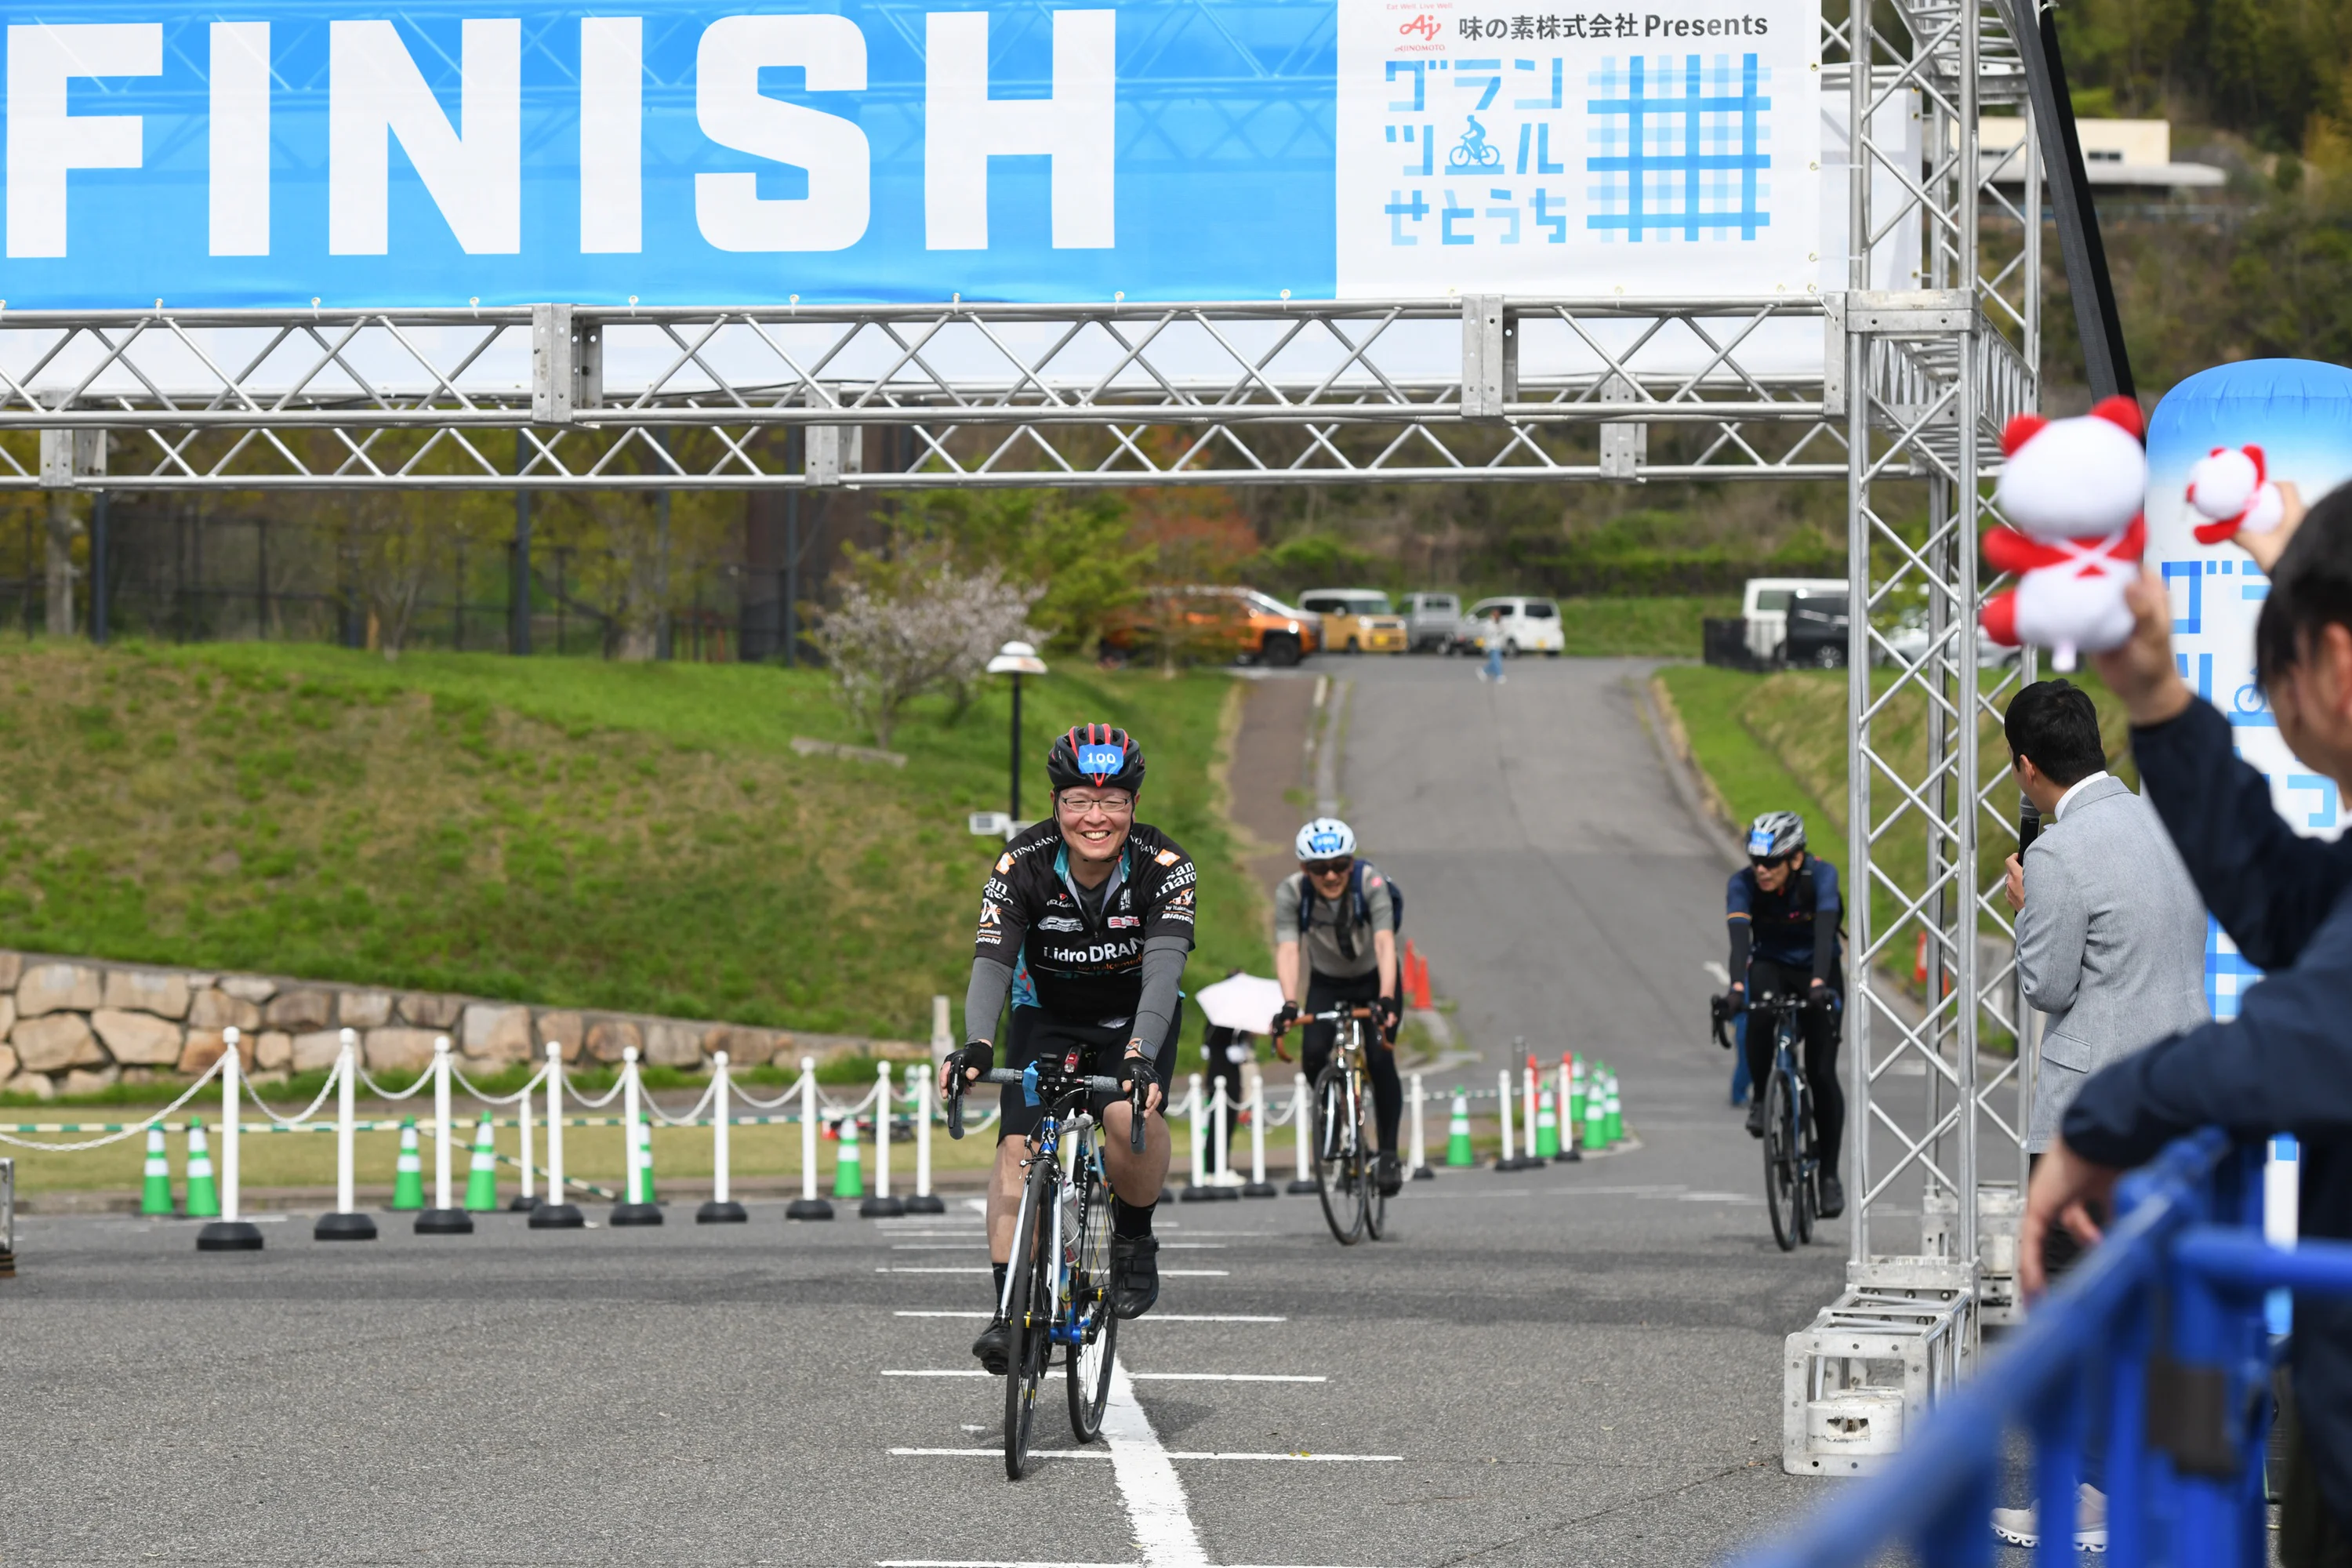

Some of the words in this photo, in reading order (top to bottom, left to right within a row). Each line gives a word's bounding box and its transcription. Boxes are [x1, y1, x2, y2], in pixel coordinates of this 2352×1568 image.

[1459, 13, 1639, 41] 味の素株式会社
[1645, 14, 1768, 37] Presents
[1385, 57, 1563, 112] グラン
[6, 9, 1116, 257] FINISH
[1385, 187, 1566, 246] せとうち
[1087, 752, 1116, 764] 100
[989, 877, 1008, 895] an
